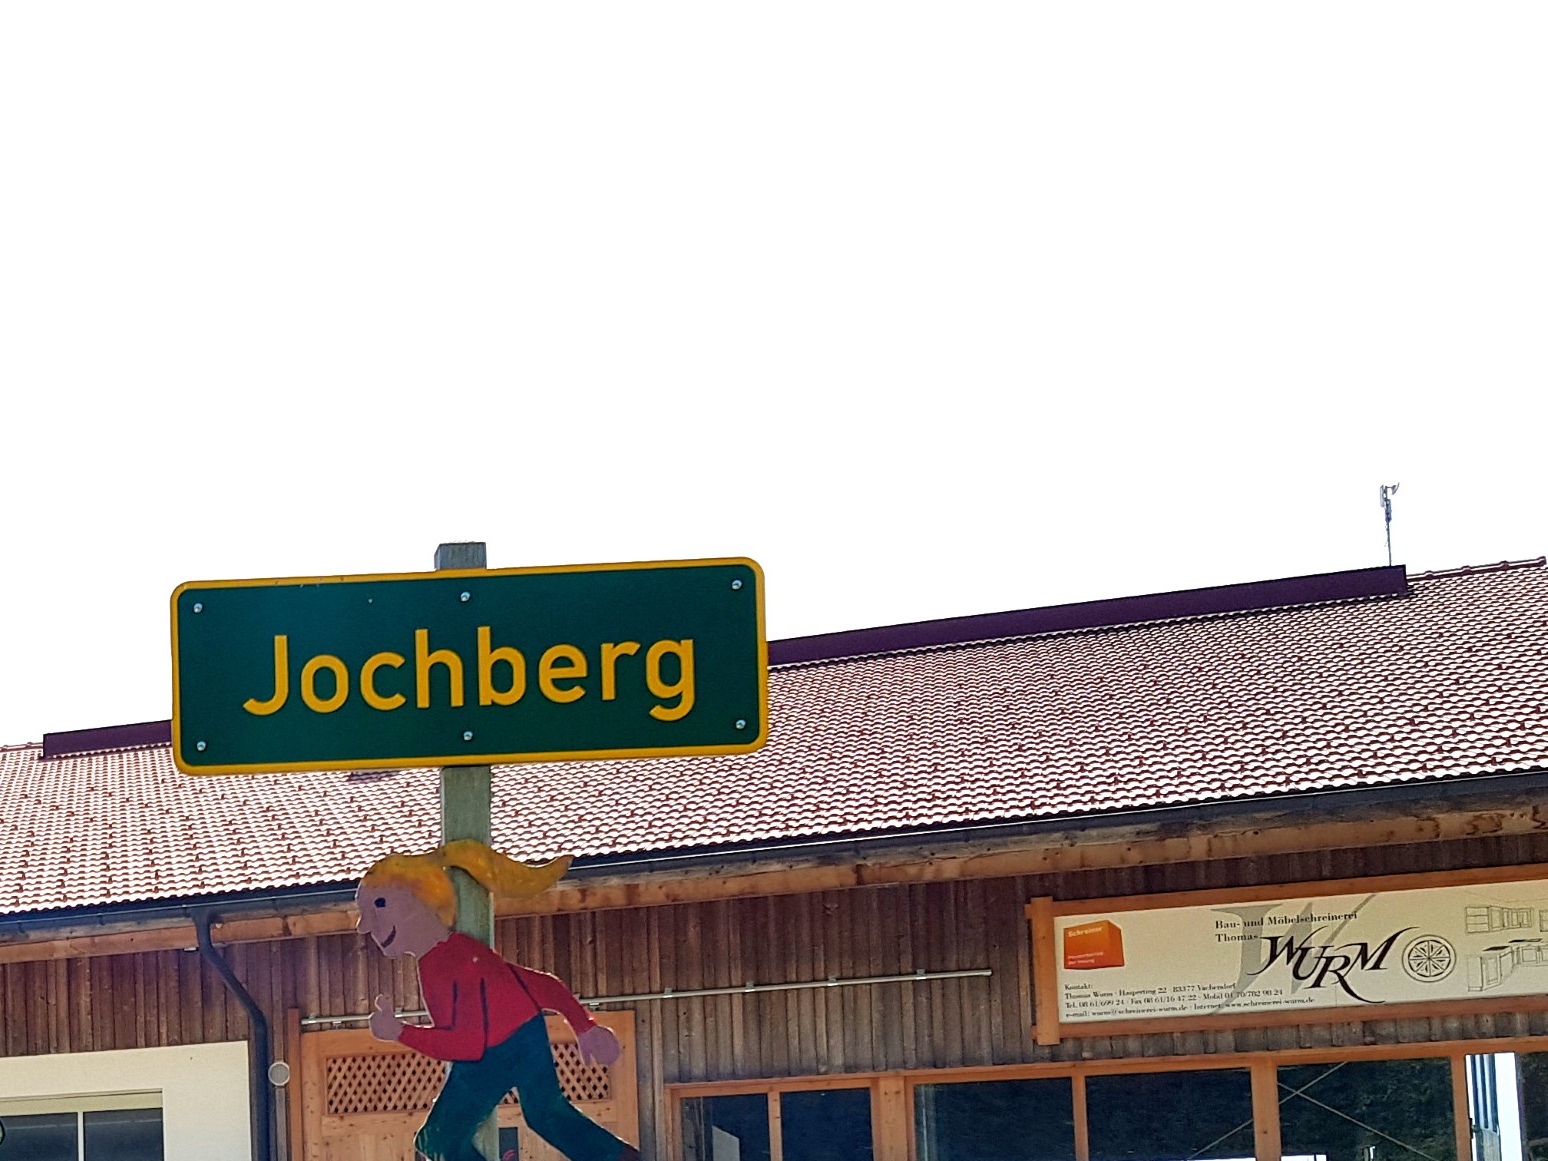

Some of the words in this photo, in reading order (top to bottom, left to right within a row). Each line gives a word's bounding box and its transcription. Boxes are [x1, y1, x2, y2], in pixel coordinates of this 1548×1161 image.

[242, 626, 695, 722] Jochberg
[1215, 919, 1241, 930] Bau-
[1243, 916, 1264, 928] und
[1267, 911, 1358, 926] Möbelschreinerei
[1215, 933, 1259, 943] Thomas
[1246, 925, 1421, 1004] WURM
